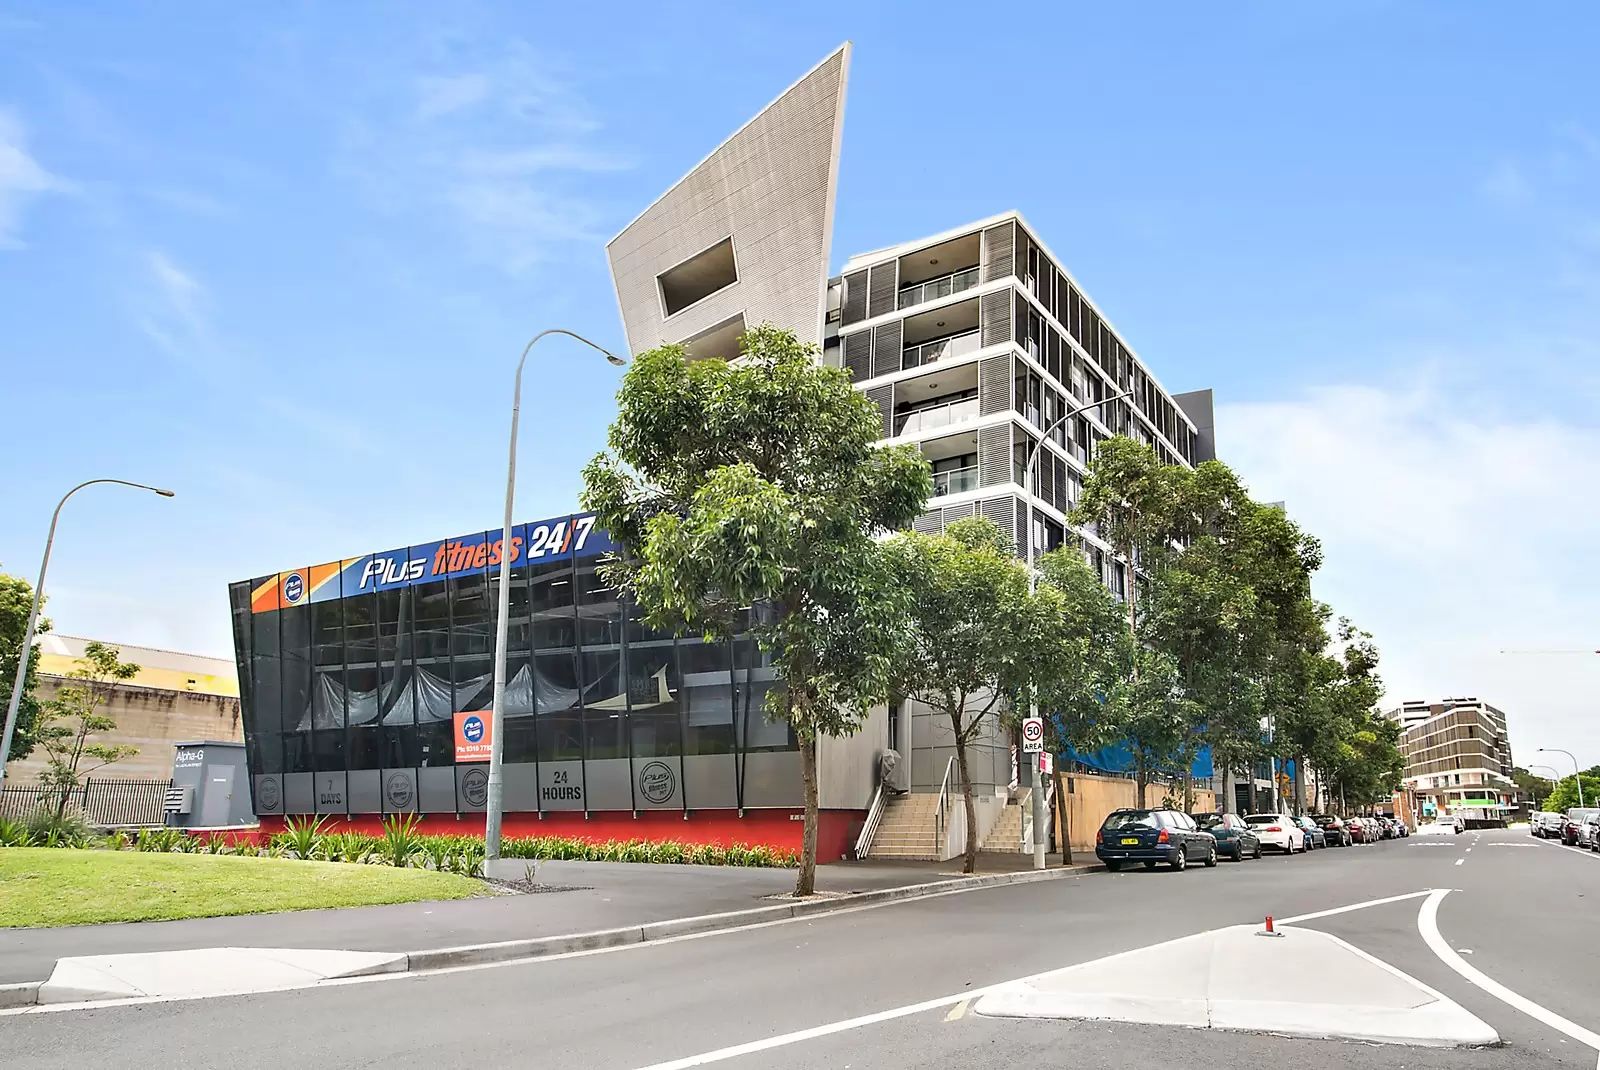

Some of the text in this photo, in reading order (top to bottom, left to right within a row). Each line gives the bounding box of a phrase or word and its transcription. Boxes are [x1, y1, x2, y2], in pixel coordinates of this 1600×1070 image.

[359, 515, 597, 590] Plus fitness 24/7
[1026, 726, 1040, 736] 50
[175, 749, 204, 763] Alpha-G
[553, 771, 568, 784] 24
[644, 772, 669, 783] Plus
[327, 780, 333, 790] 7
[321, 792, 342, 804] DAYS
[542, 786, 582, 800] HOURS
